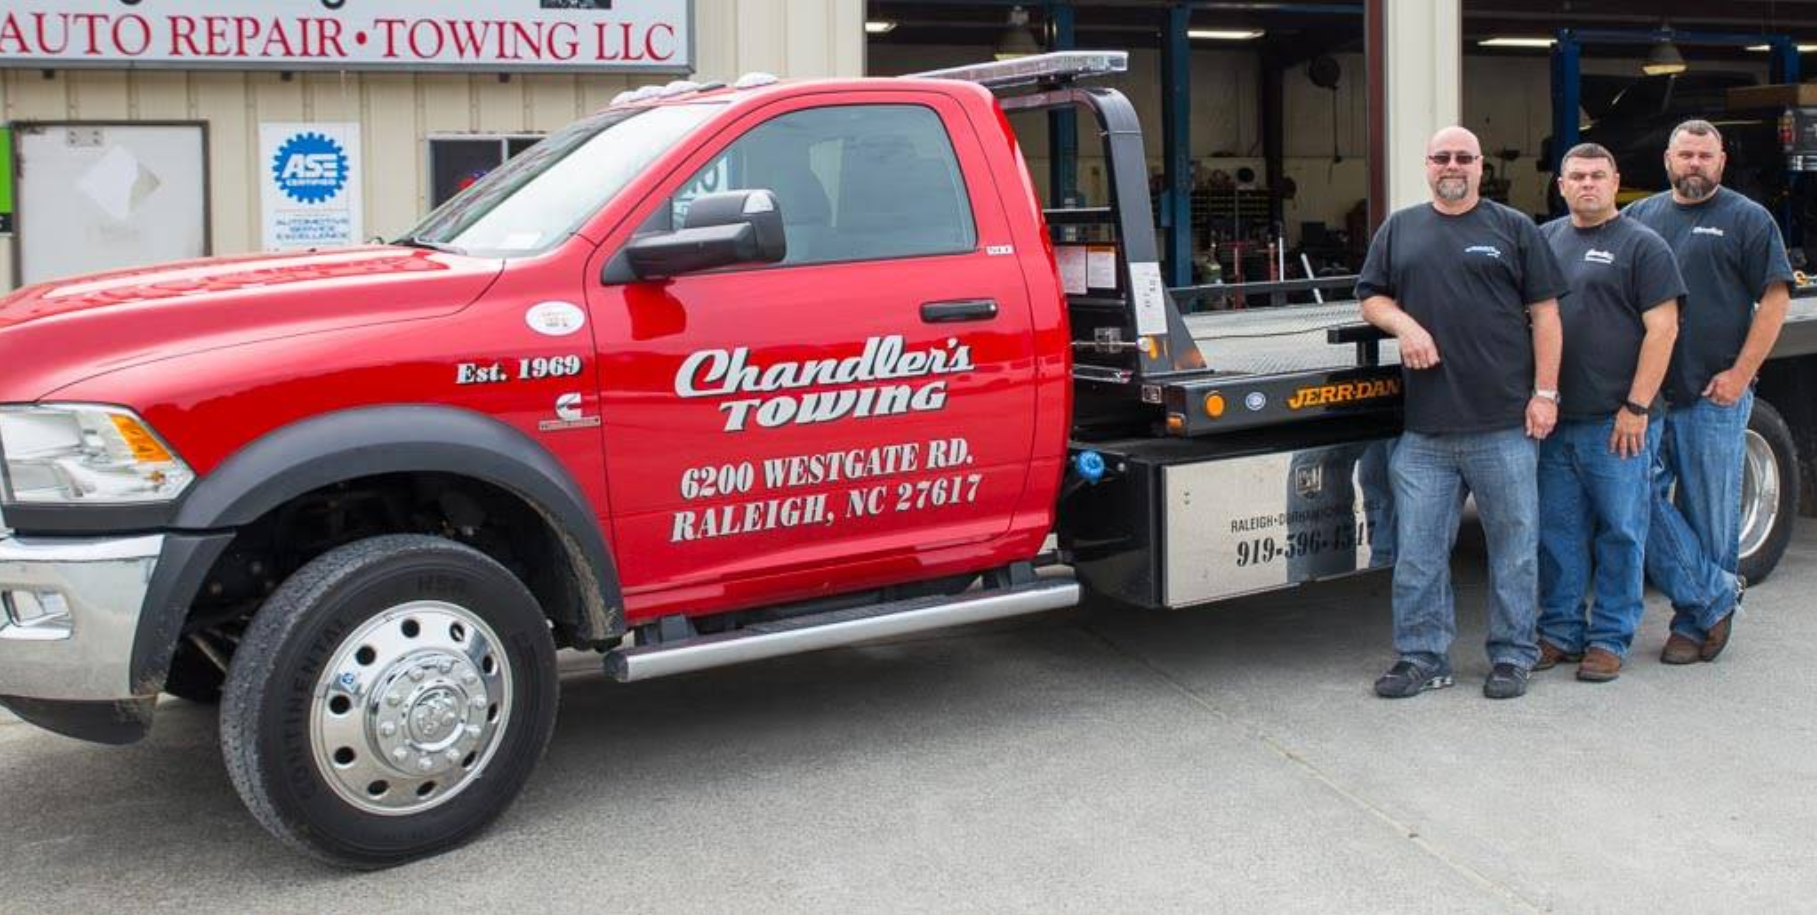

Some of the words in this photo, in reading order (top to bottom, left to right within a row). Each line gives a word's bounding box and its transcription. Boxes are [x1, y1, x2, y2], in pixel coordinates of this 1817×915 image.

[0, 12, 151, 56] AUTO
[594, 22, 675, 61] LLC
[281, 152, 338, 178] ASE
[455, 362, 508, 385] Est.
[517, 354, 583, 380] 1969
[674, 334, 976, 398] Chandler's
[719, 380, 949, 432] TOWING
[680, 460, 755, 500] 6200
[763, 442, 920, 489] WESTGATE
[926, 437, 974, 469] RD.
[669, 492, 835, 543] RALEIGH,
[846, 486, 887, 519] NC
[895, 473, 983, 513] 27617
